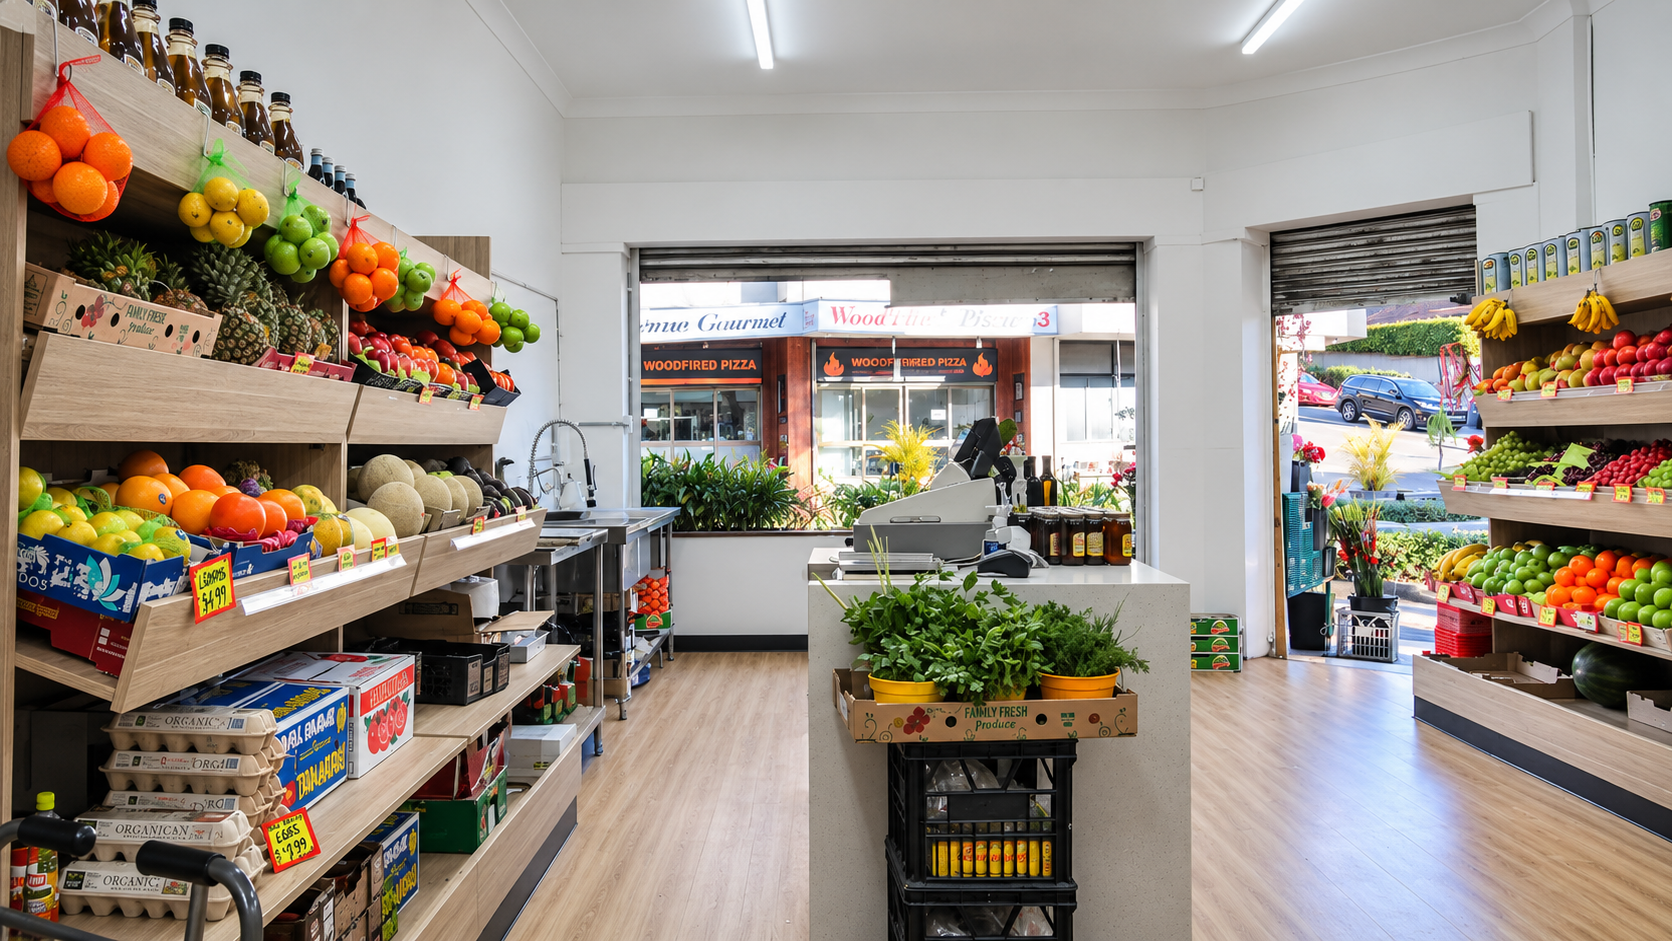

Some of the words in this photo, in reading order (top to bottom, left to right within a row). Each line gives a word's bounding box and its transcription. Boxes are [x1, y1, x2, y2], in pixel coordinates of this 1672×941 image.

[643, 360, 717, 371] WOODFIRED
[721, 359, 757, 371] PIZZA
[938, 357, 967, 367] PIZZA
[999, 705, 1028, 718] FRESH
[975, 719, 1016, 732] Produce
